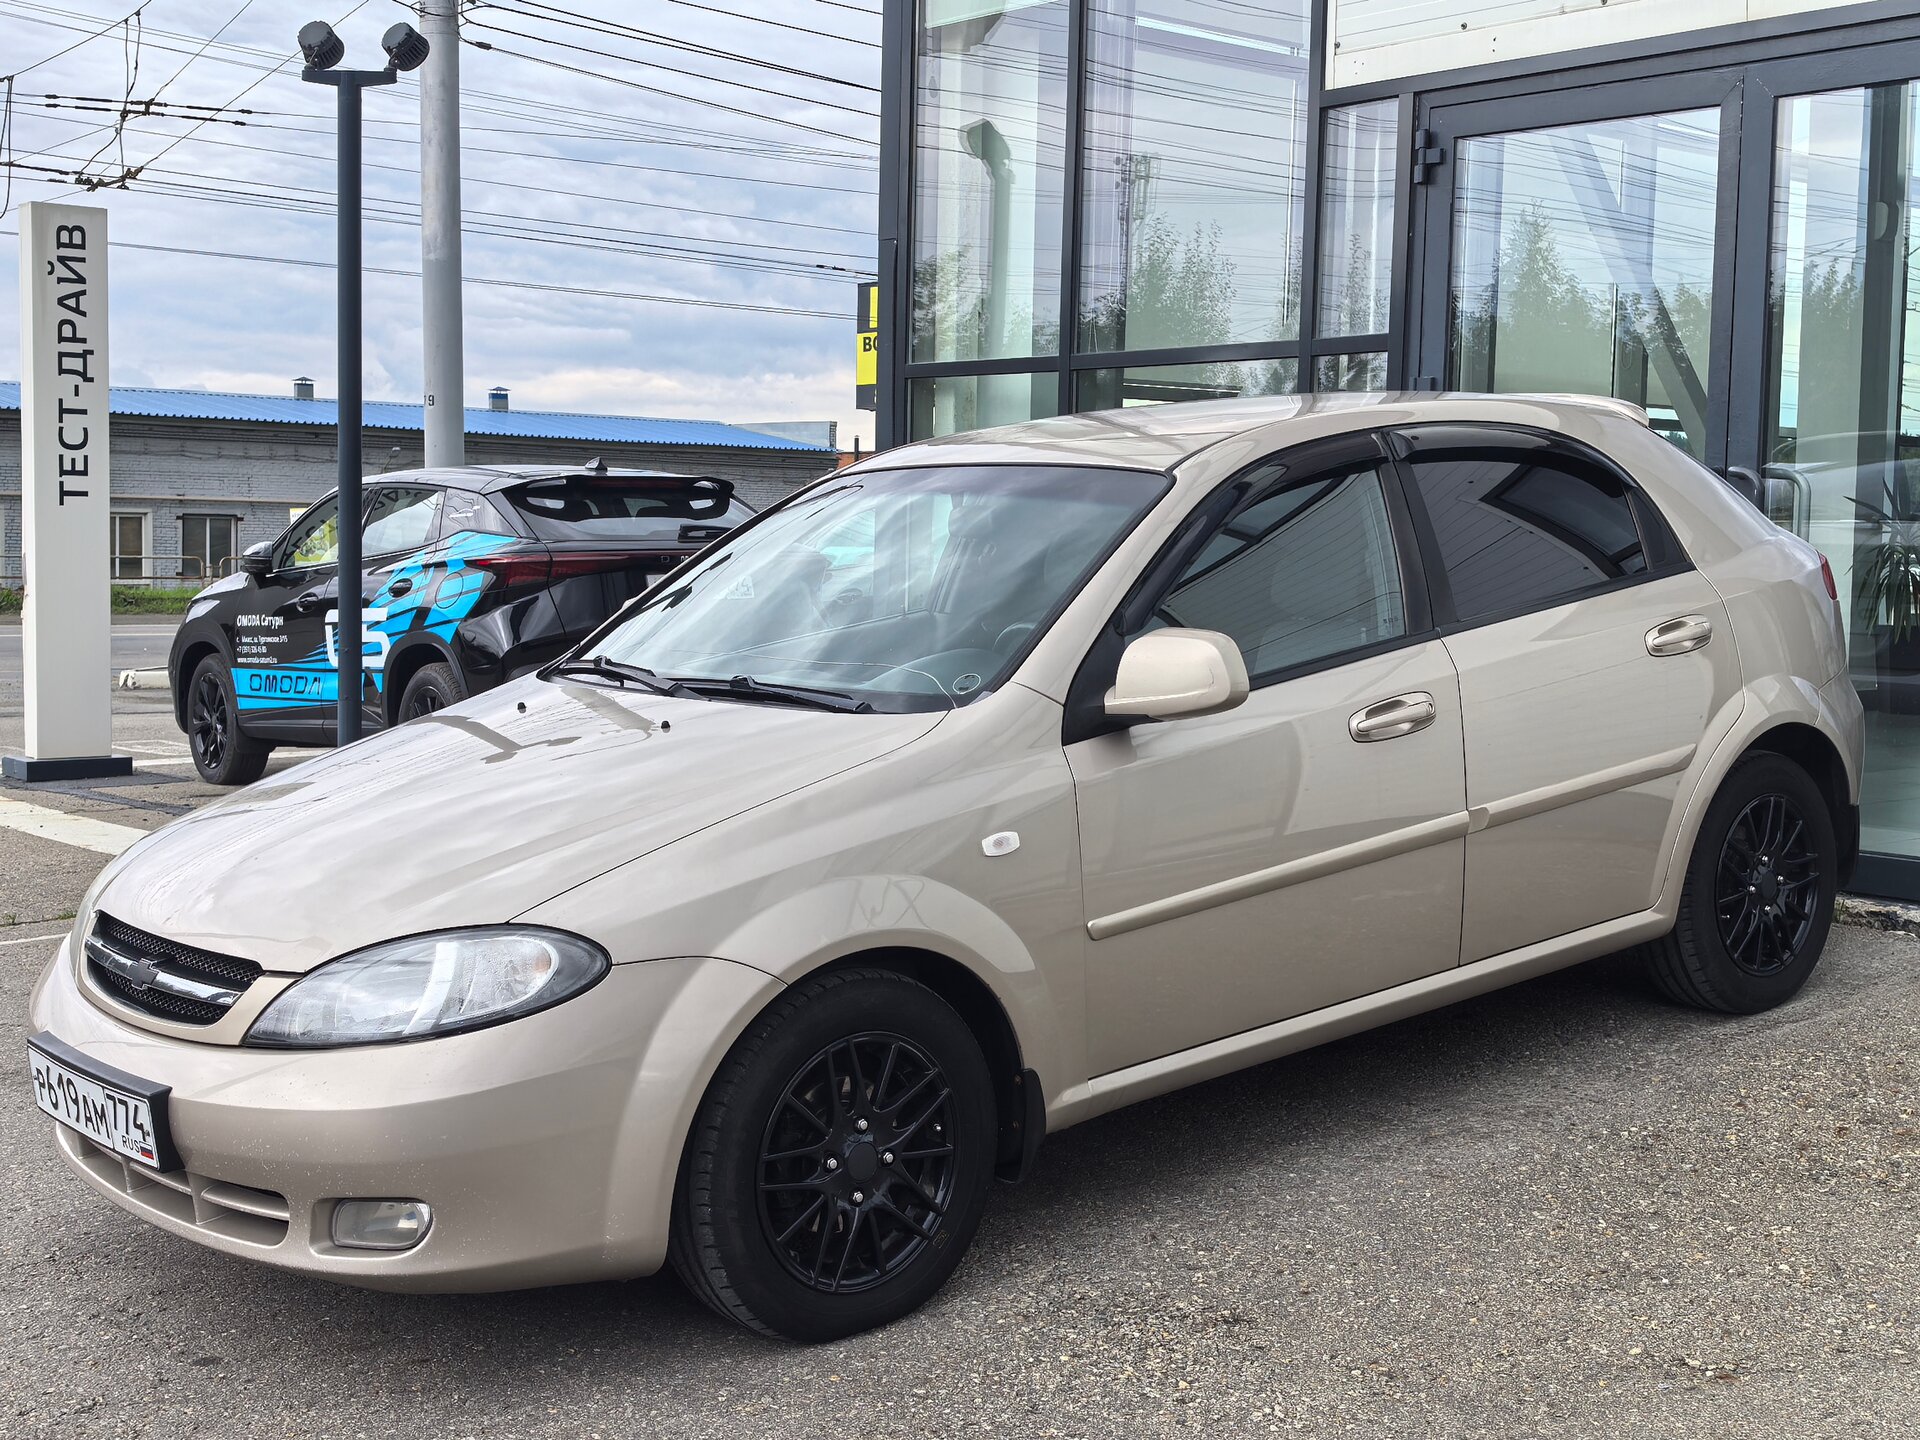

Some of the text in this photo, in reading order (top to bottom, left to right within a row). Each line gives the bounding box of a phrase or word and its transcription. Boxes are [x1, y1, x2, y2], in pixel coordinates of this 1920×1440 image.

[47, 223, 94, 505] ТЕСТ-ДРАЙВ
[236, 614, 284, 630] OMODA Сатурн
[250, 673, 321, 695] OMODA
[106, 1092, 147, 1142] 774
[121, 1135, 141, 1153] RUS
